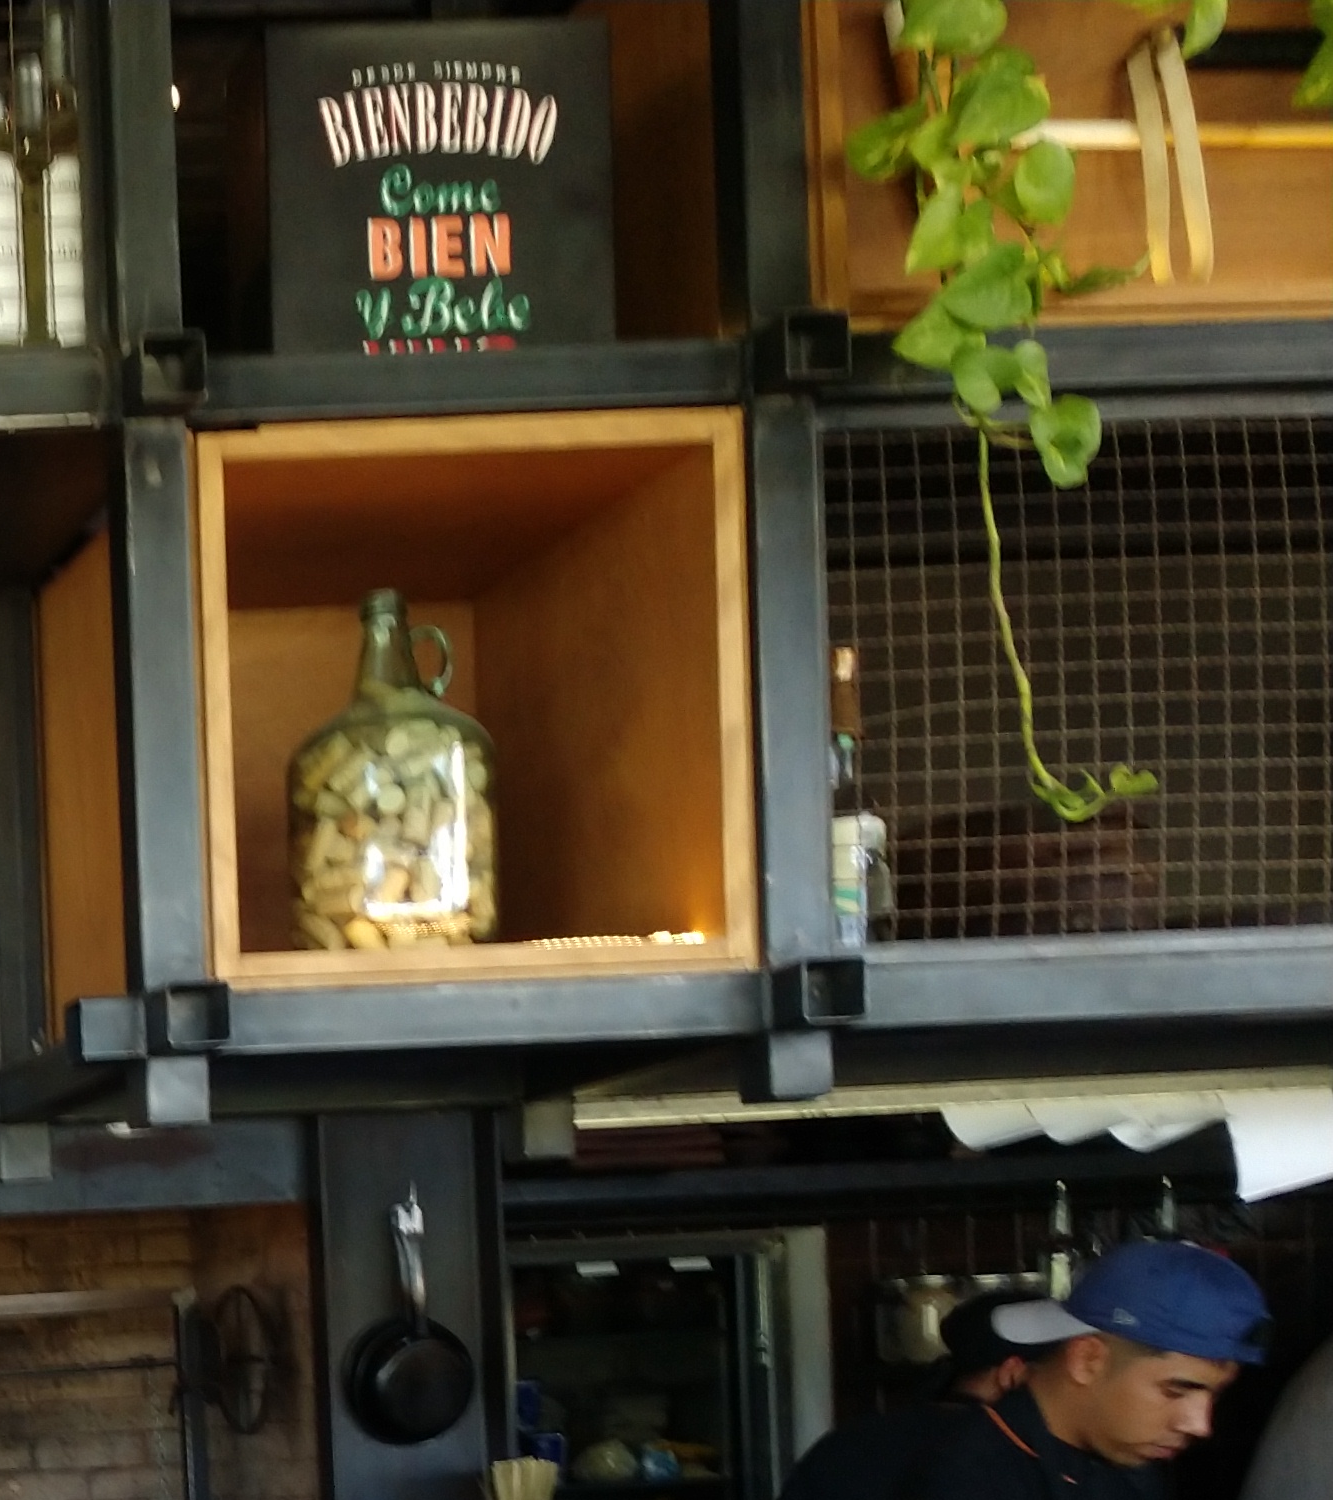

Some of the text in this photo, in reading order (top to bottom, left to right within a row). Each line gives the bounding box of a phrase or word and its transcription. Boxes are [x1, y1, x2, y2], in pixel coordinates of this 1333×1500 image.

[318, 82, 558, 168] BIENBEBIDO
[380, 163, 501, 218] Come
[367, 212, 512, 281] BIEN
